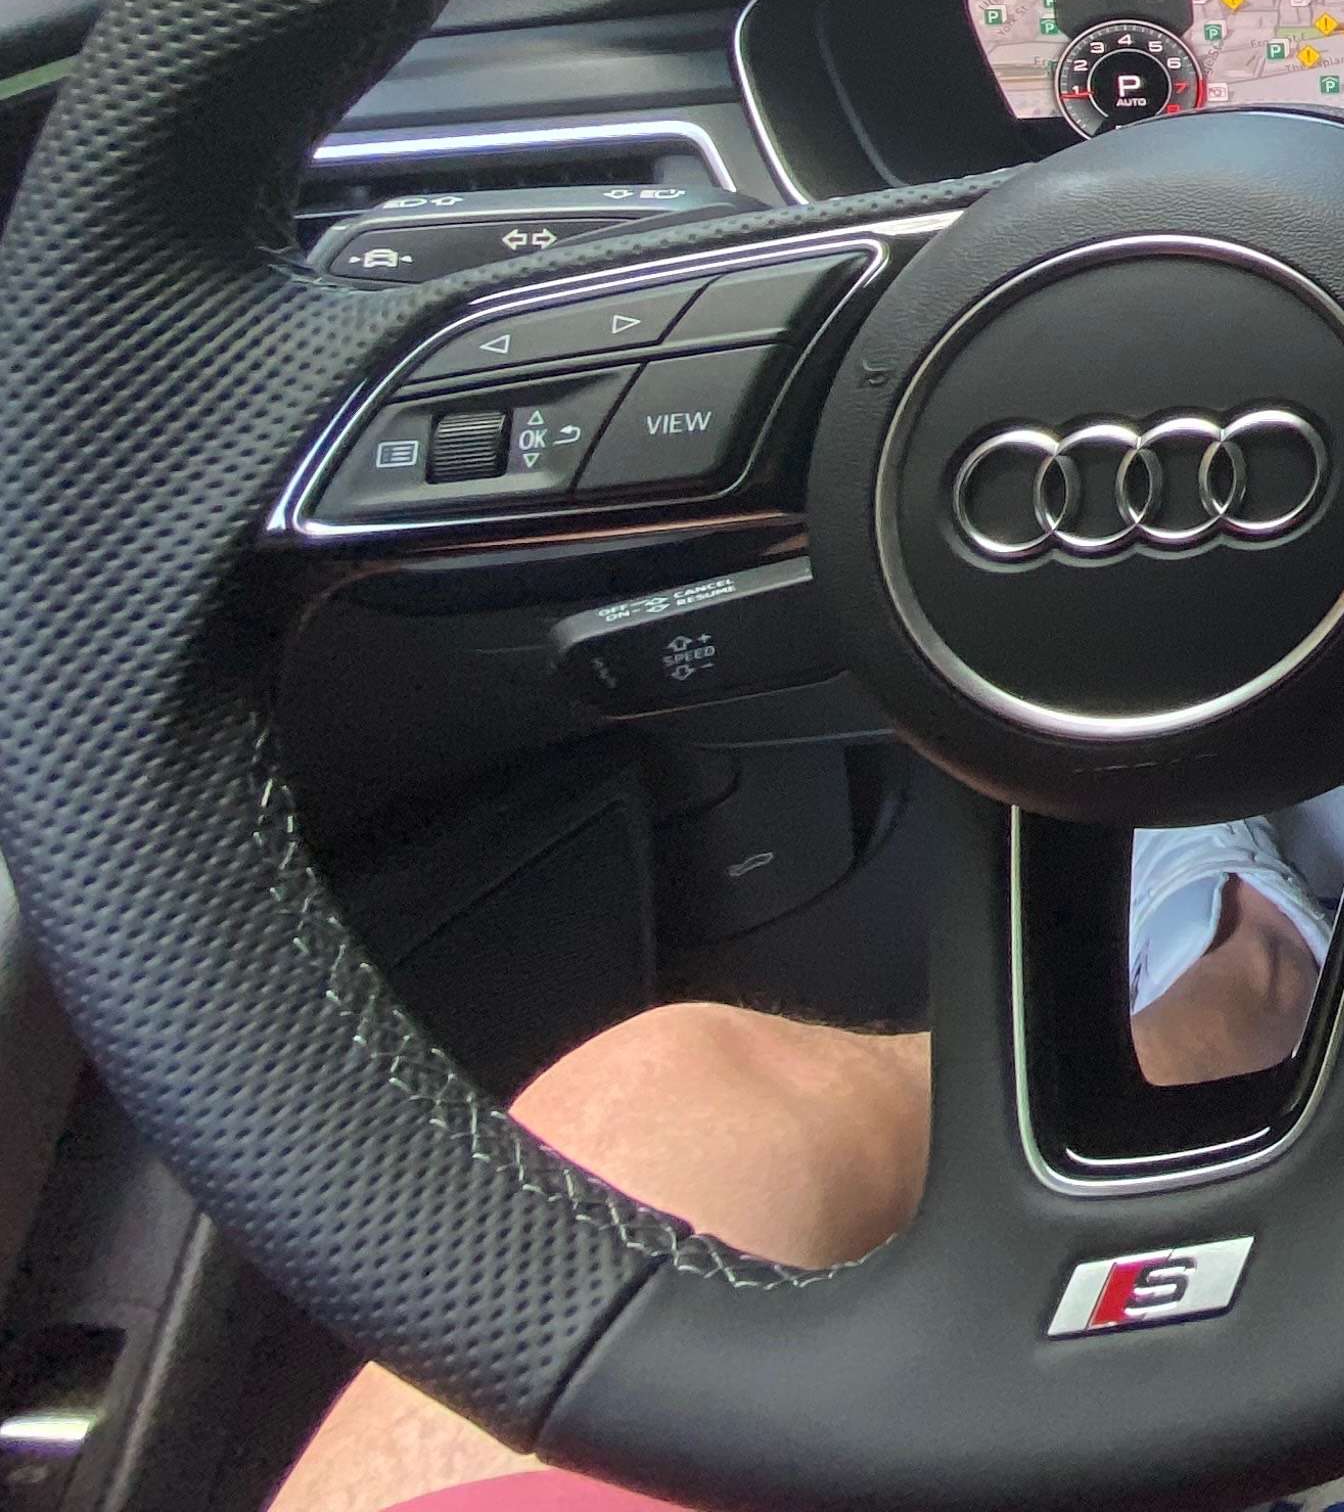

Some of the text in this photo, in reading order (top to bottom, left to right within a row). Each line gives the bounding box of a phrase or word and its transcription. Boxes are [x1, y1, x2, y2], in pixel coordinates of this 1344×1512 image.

[1090, 41, 1105, 53] 3
[1117, 34, 1133, 46] 4
[1148, 41, 1164, 53] 5
[1073, 59, 1089, 72] 2
[1166, 57, 1182, 69] 6
[1118, 75, 1141, 98] P
[1174, 83, 1187, 94] 7
[1116, 98, 1147, 107] AUTO
[646, 411, 712, 435] VIEW
[519, 429, 548, 450] OK
[599, 578, 735, 616] OFF CANCEL
[606, 585, 736, 622] ON RESUME
[662, 646, 715, 666] SPEED
[1123, 1256, 1197, 1319] S
